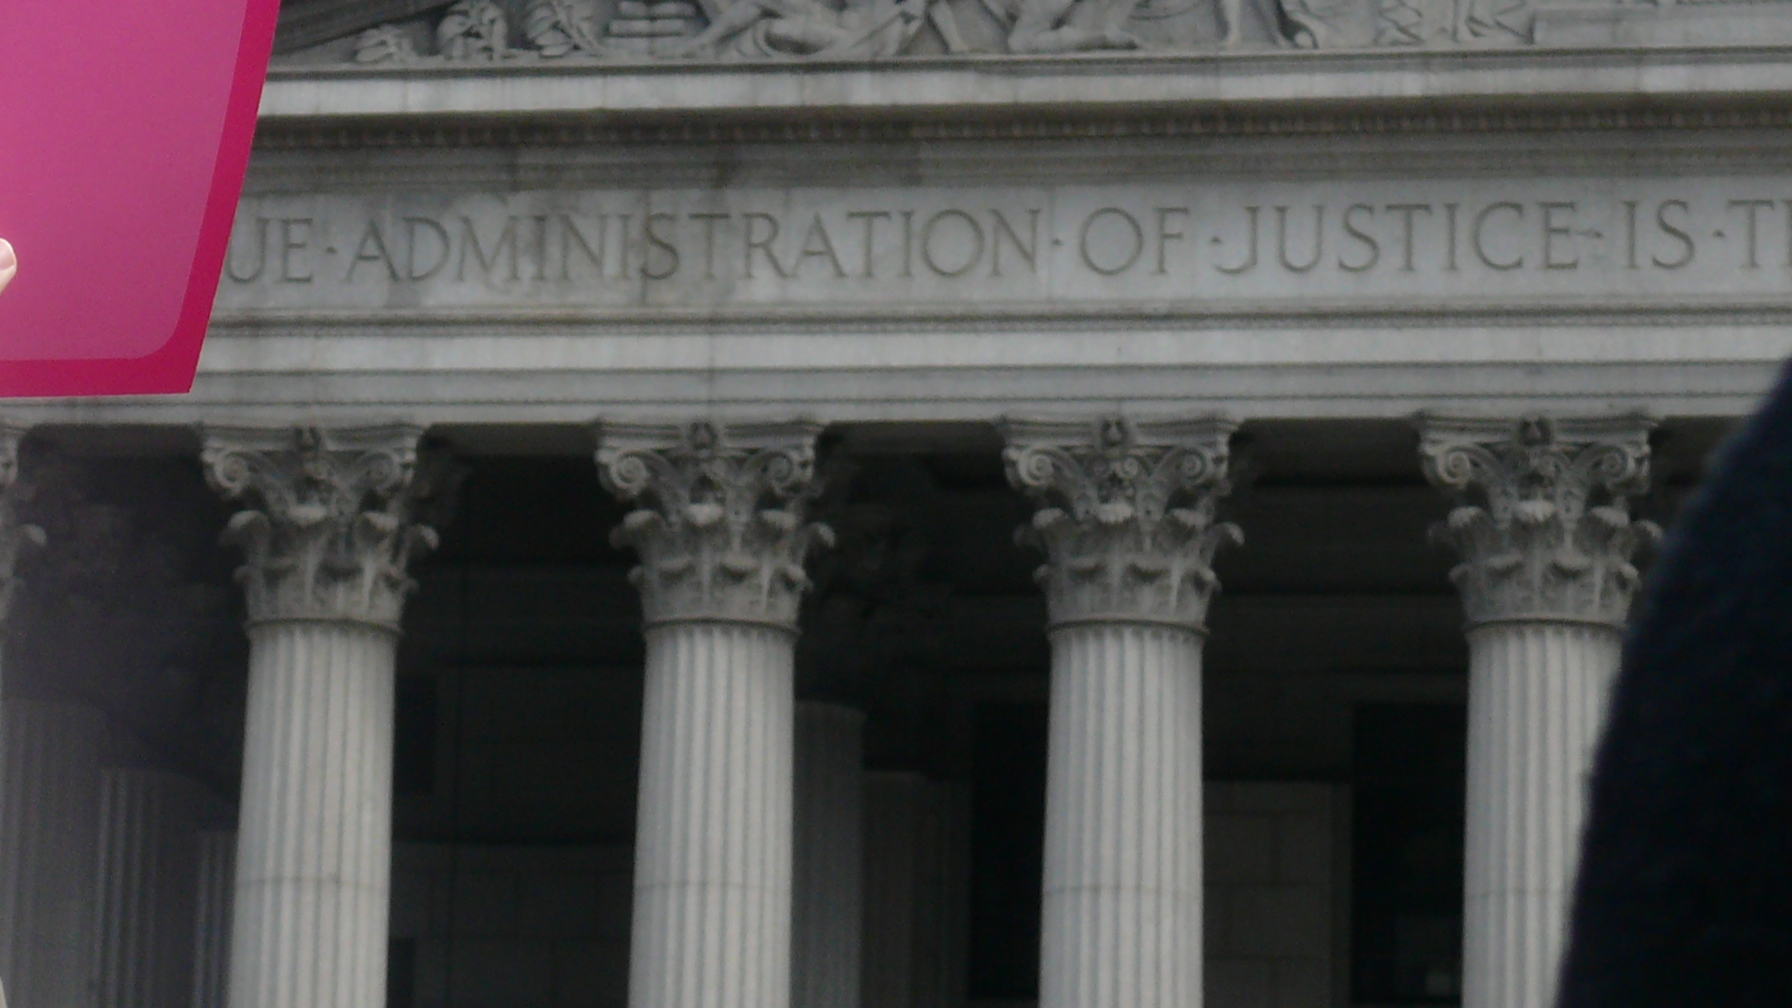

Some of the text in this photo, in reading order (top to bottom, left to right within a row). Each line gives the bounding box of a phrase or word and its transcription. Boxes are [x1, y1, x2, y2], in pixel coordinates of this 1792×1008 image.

[340, 205, 1040, 282] ADMINISTRATION
[1079, 206, 1191, 276] OF
[1212, 200, 1579, 275] JUSTICE
[1622, 198, 1695, 271] IS
